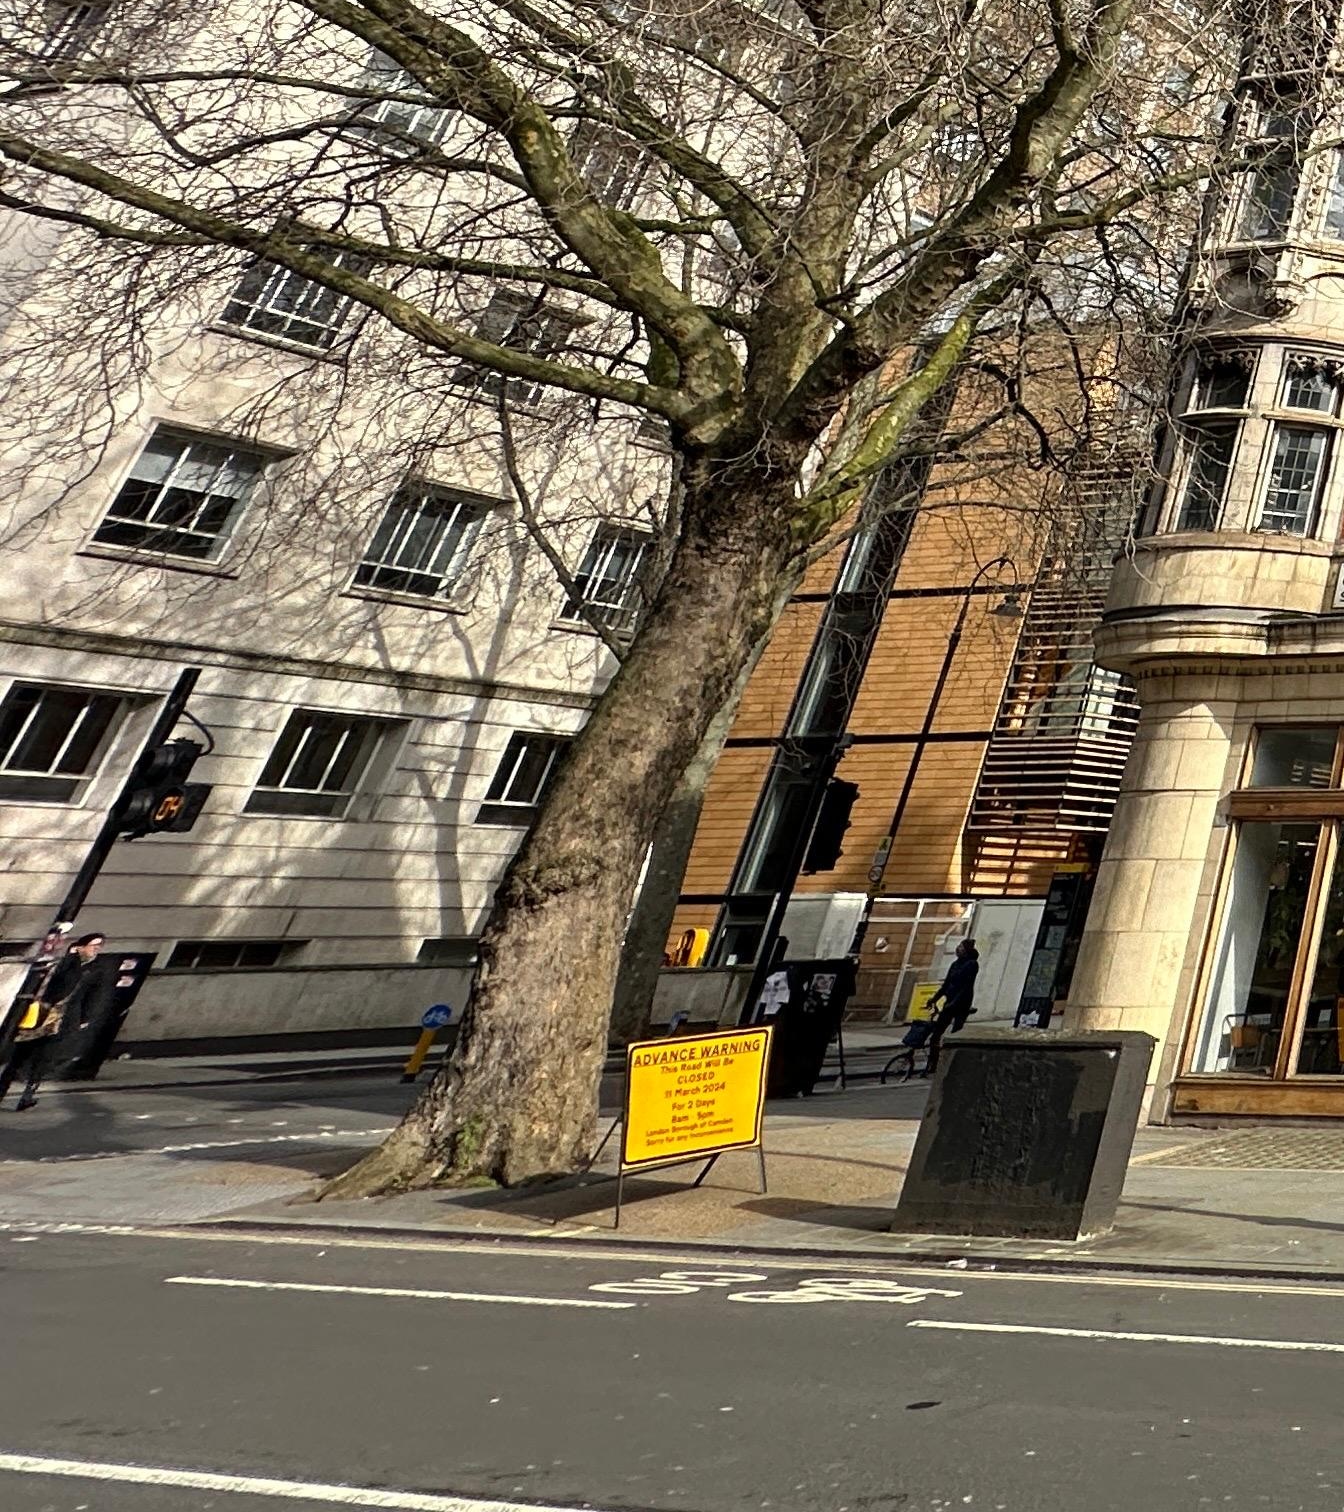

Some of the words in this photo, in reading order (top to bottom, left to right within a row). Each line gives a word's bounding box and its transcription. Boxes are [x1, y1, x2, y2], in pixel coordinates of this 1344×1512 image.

[634, 1047, 696, 1067] ADVANCE
[700, 1039, 760, 1057] WARNING
[677, 1071, 715, 1085] CLOSED
[675, 1086, 700, 1096] March
[703, 1081, 726, 1093] 2024
[688, 1100, 693, 1109] 2
